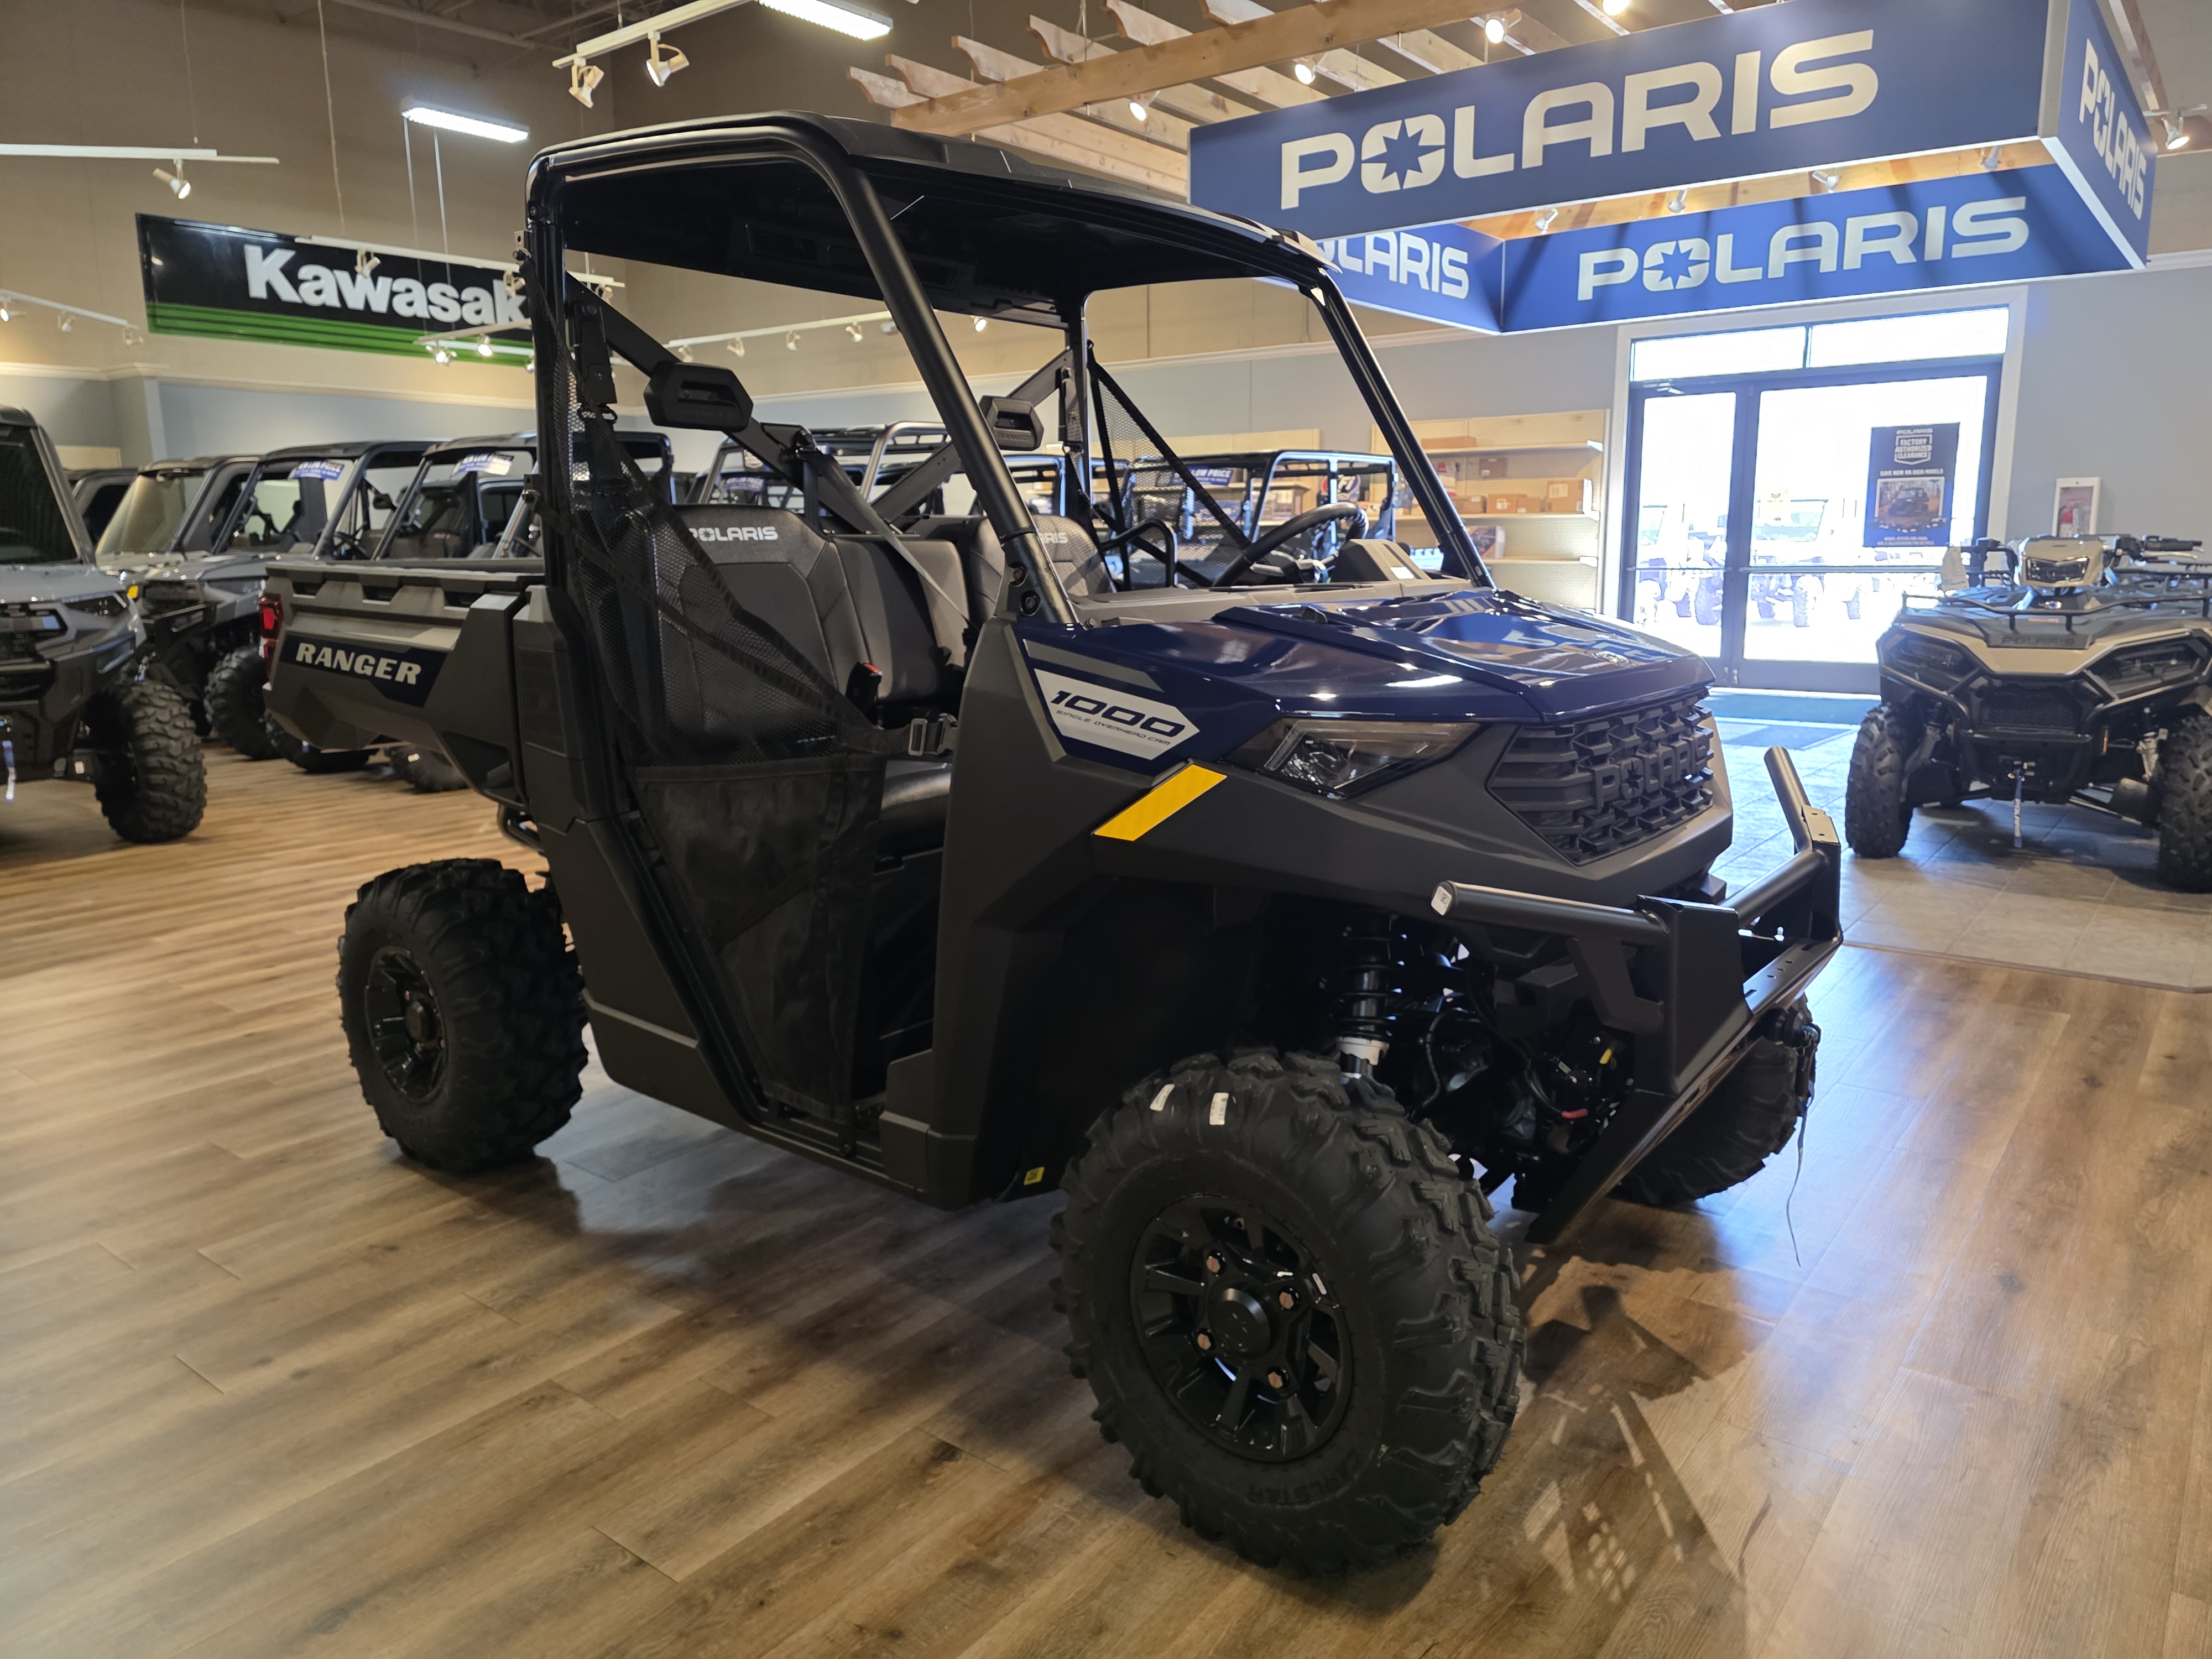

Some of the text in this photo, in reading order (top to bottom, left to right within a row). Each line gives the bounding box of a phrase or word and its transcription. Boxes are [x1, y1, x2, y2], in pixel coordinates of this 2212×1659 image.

[1281, 29, 1879, 210] POLARIS
[2079, 38, 2146, 220] POLARIS
[1318, 231, 1469, 299] LARIS
[1577, 196, 2030, 301] POLARIS
[244, 244, 531, 330] Kawasak
[1207, 469, 1232, 478] PRICE
[296, 642, 421, 685] RANGER
[1050, 690, 1185, 737] 1000
[1056, 710, 1171, 746] SINGLE OVERHEAD CAM
[1593, 733, 1709, 811] POLARIS
